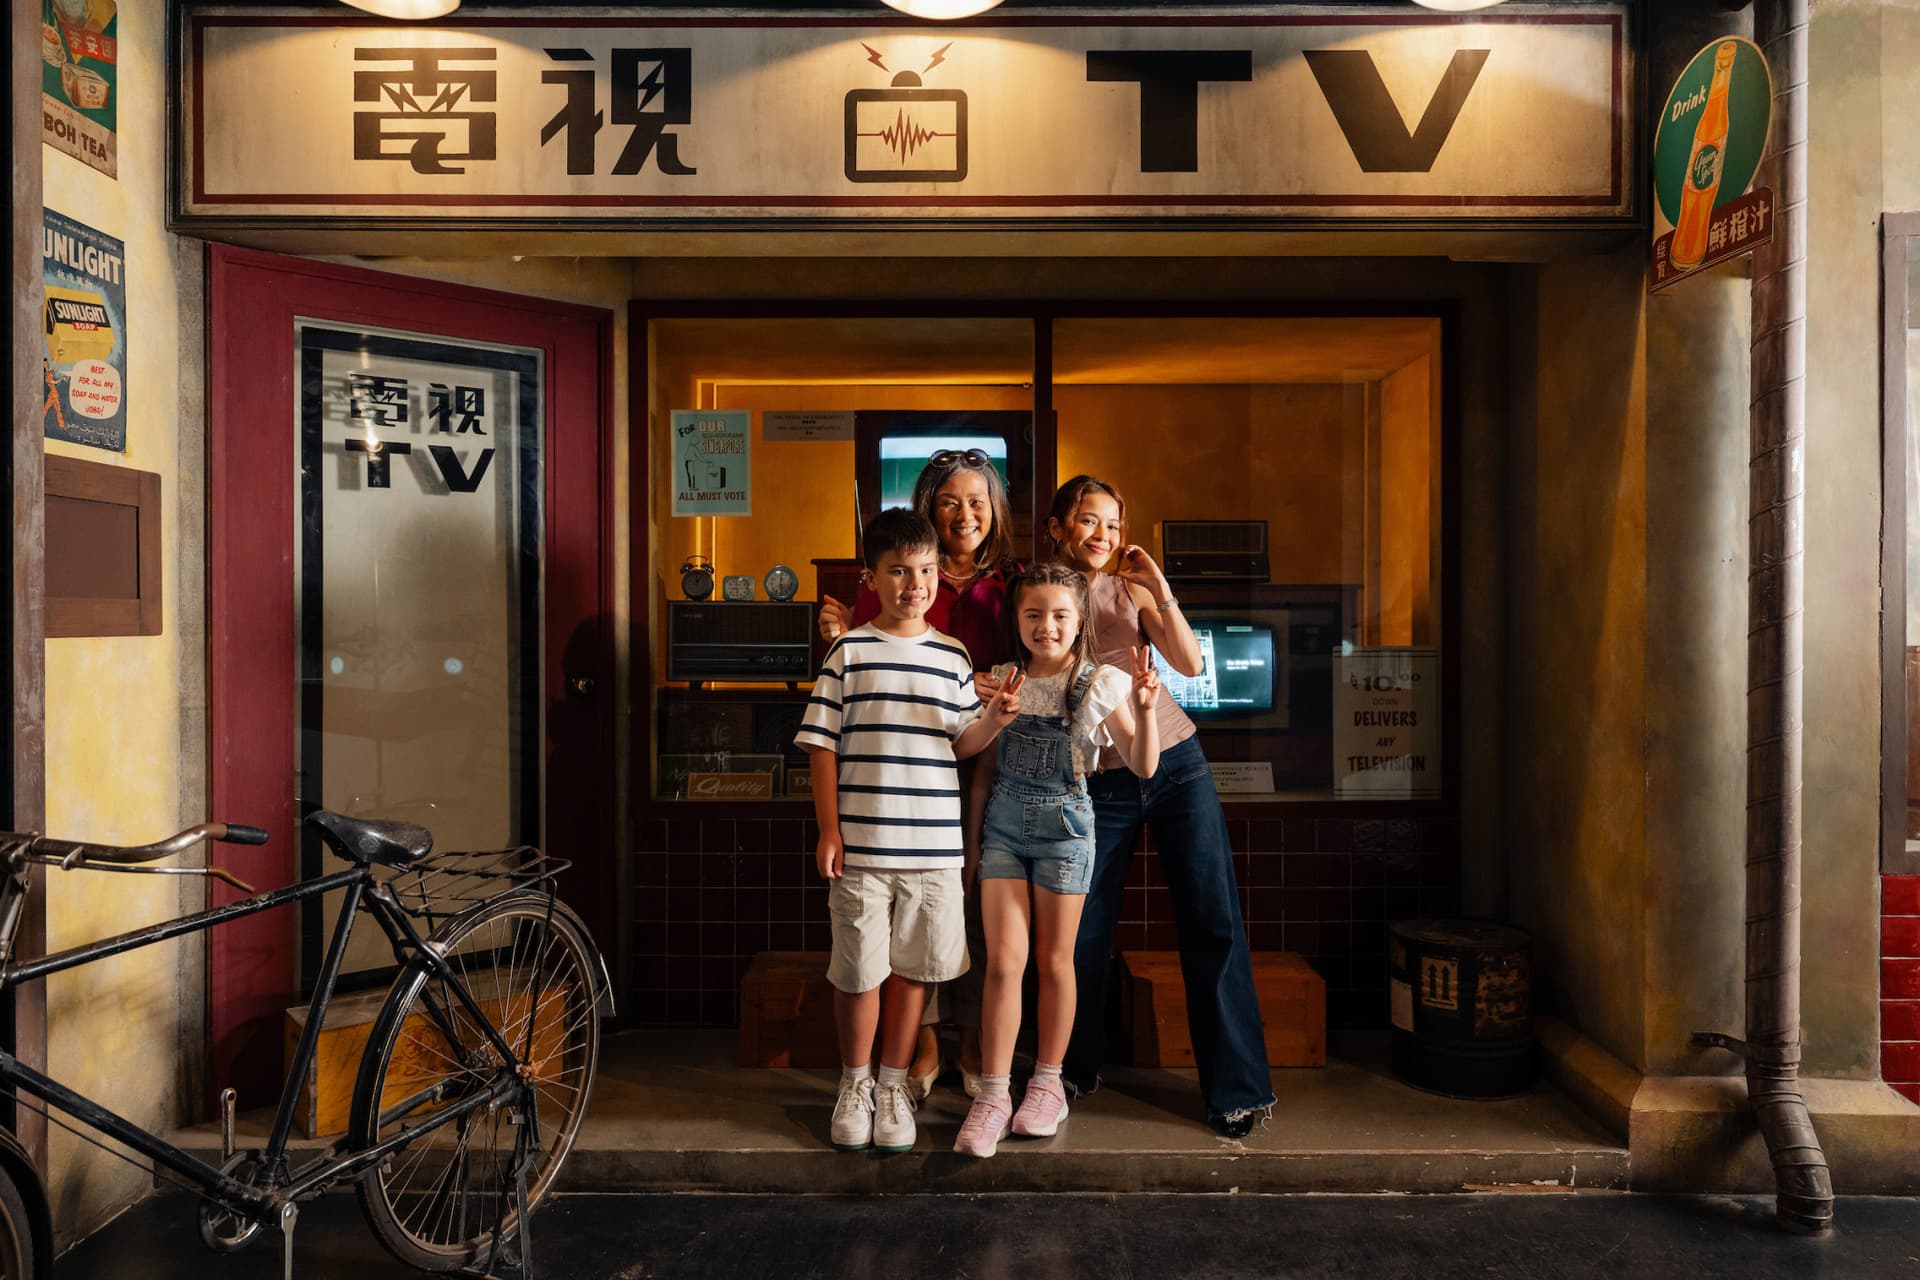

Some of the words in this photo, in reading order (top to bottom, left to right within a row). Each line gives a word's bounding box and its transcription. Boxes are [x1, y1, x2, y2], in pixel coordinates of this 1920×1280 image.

[353, 47, 697, 175] 電視
[1086, 49, 1492, 173] TV
[1671, 85, 1707, 123] Drink
[44, 111, 76, 145] BOH
[81, 132, 109, 162] TEA
[1709, 200, 1769, 254] 鮮橙汁
[43, 226, 121, 285] UNLIGHT
[54, 300, 107, 324] SUNLIGHT
[75, 322, 96, 331] SOAP
[90, 365, 105, 374] BEST
[78, 376, 90, 385] FOR
[92, 378, 103, 387] ALL
[104, 381, 114, 390] MY
[72, 389, 87, 399] SOAP
[88, 392, 101, 401] AND
[101, 394, 118, 404] WATER
[350, 373, 487, 435] 電視
[678, 422, 697, 438] FOR
[698, 419, 726, 432] OUR
[702, 438, 745, 455] SINGAPORE
[345, 438, 496, 492] TV
[679, 491, 696, 502] ALL
[696, 490, 722, 501] MUST
[723, 490, 746, 501] VOTE
[1372, 697, 1399, 706] DOWN
[1354, 711, 1417, 727] DELIVERS
[1376, 736, 1397, 747] ANY
[1348, 755, 1426, 772] TELEVISION
[694, 776, 767, 796] Quality
